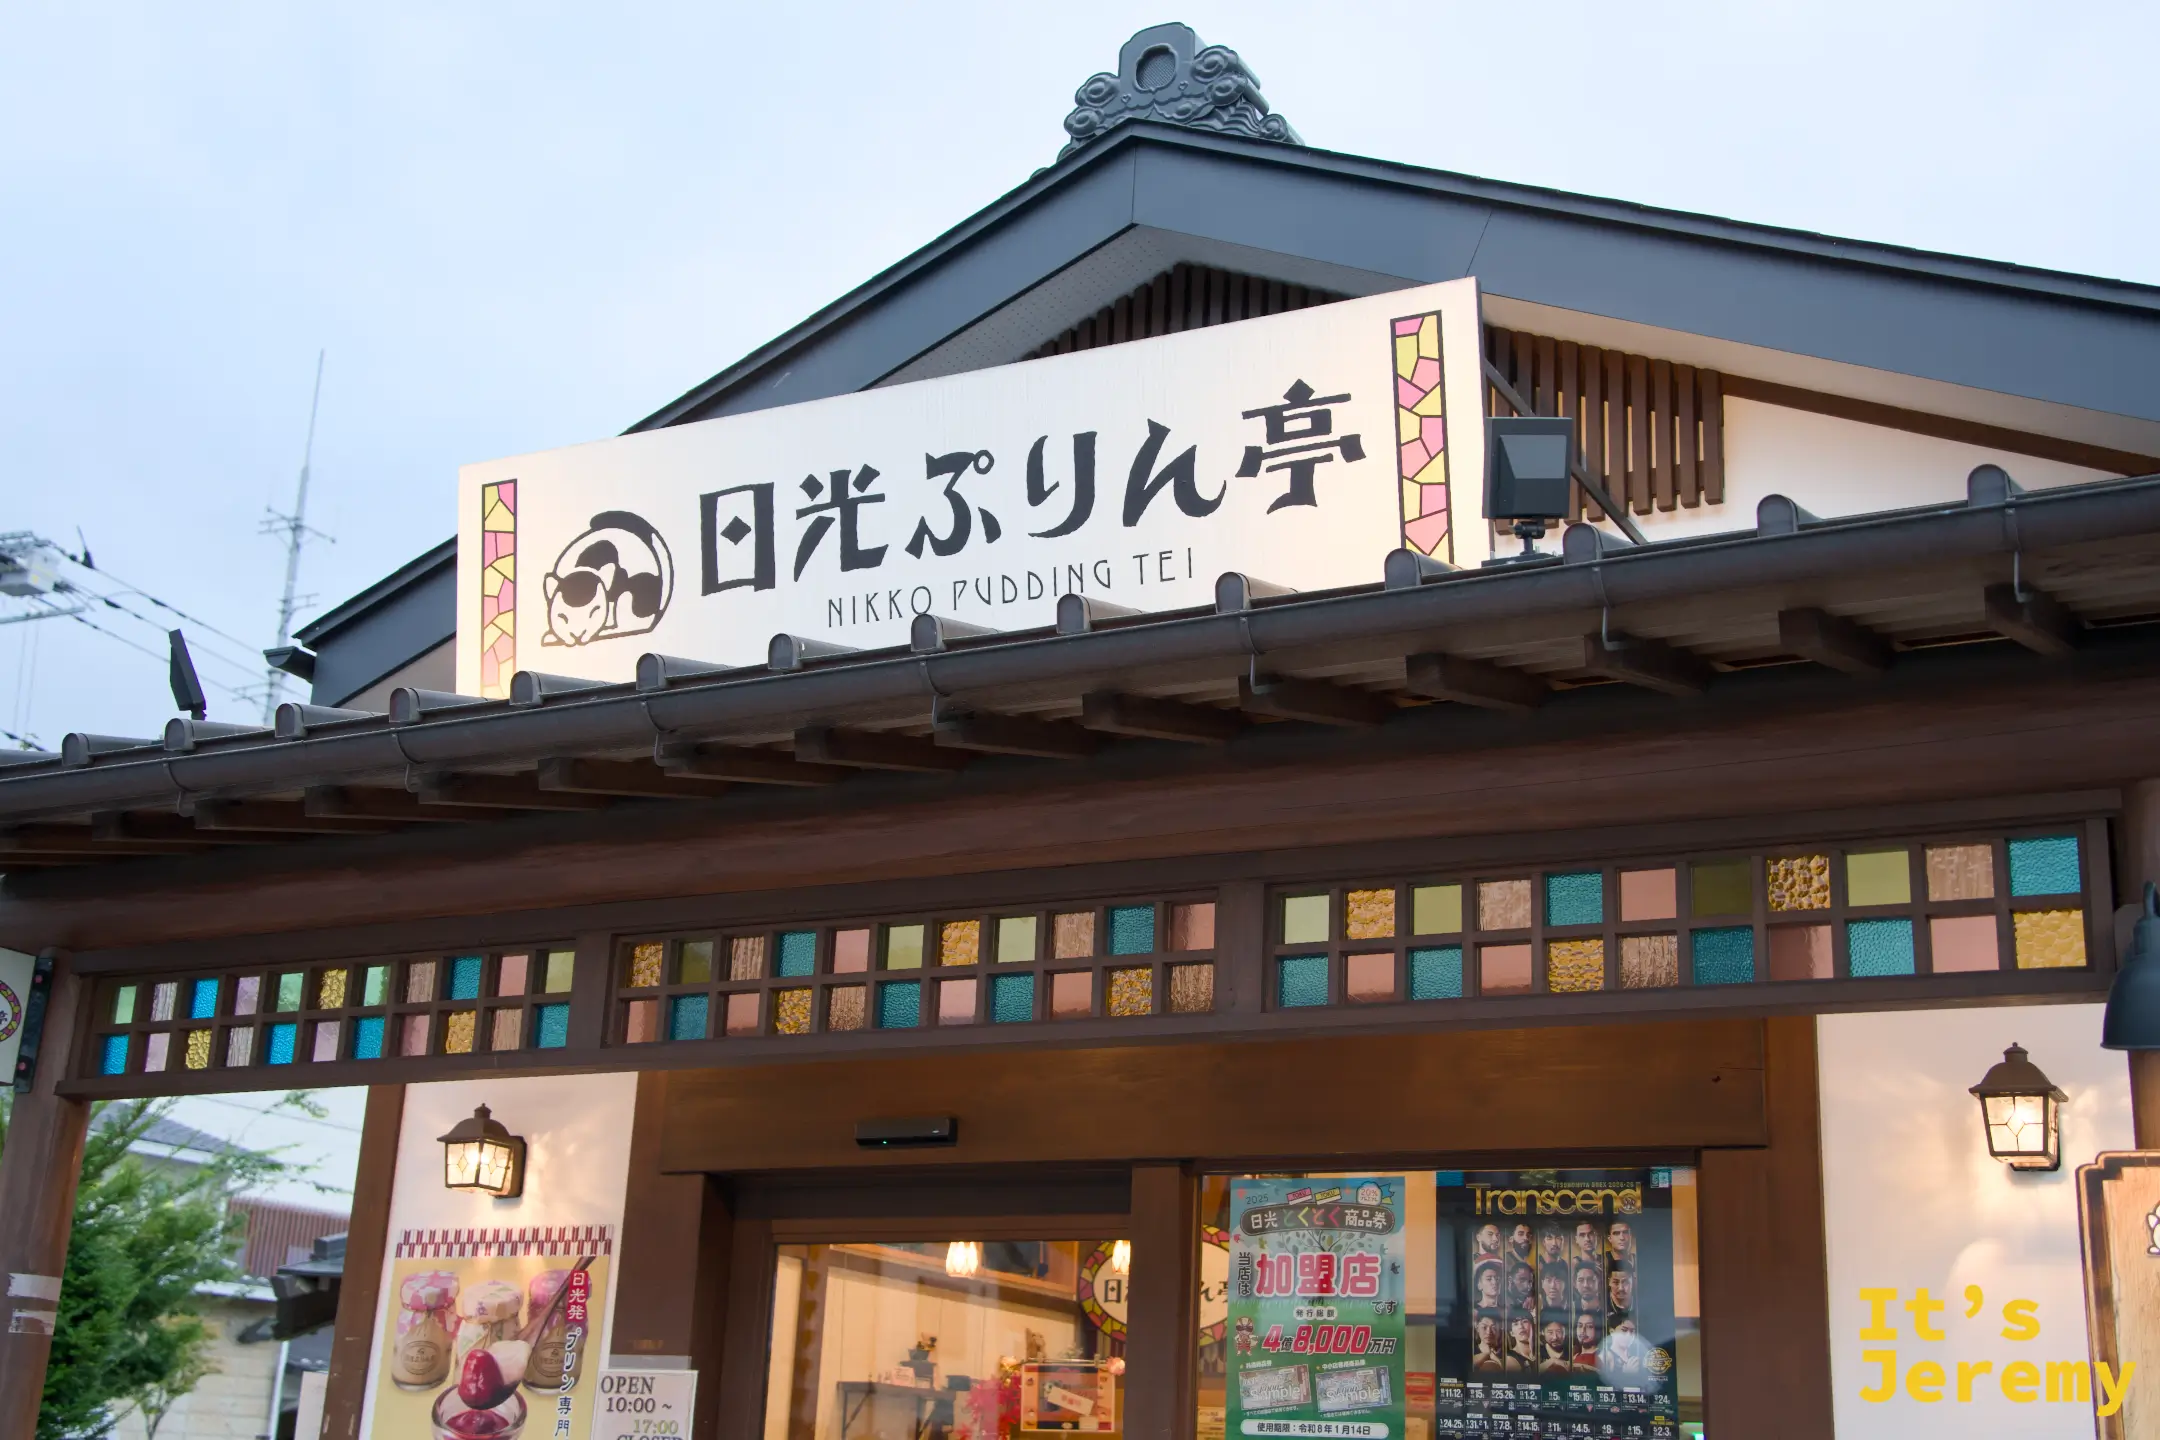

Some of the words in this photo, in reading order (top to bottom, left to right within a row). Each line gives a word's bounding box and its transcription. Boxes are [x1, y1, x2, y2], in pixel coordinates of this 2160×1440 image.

[699, 378, 1366, 598] 日光ぷりん亭
[827, 585, 932, 628] NIKKO
[952, 559, 1112, 611] PUDDING
[1132, 547, 1193, 585] TEI
[1246, 1193, 1269, 1205] 2025
[1466, 1182, 1643, 1215] Transcend
[1238, 1252, 1251, 1295] 当店は
[1255, 1253, 1380, 1297] 加盟店
[567, 1272, 586, 1320] 日光発
[1371, 1300, 1397, 1314] です
[601, 1375, 656, 1395] OPEN
[1327, 1386, 1381, 1404] Sample
[606, 1397, 656, 1413] 10:00
[632, 1419, 679, 1434] 17:00
